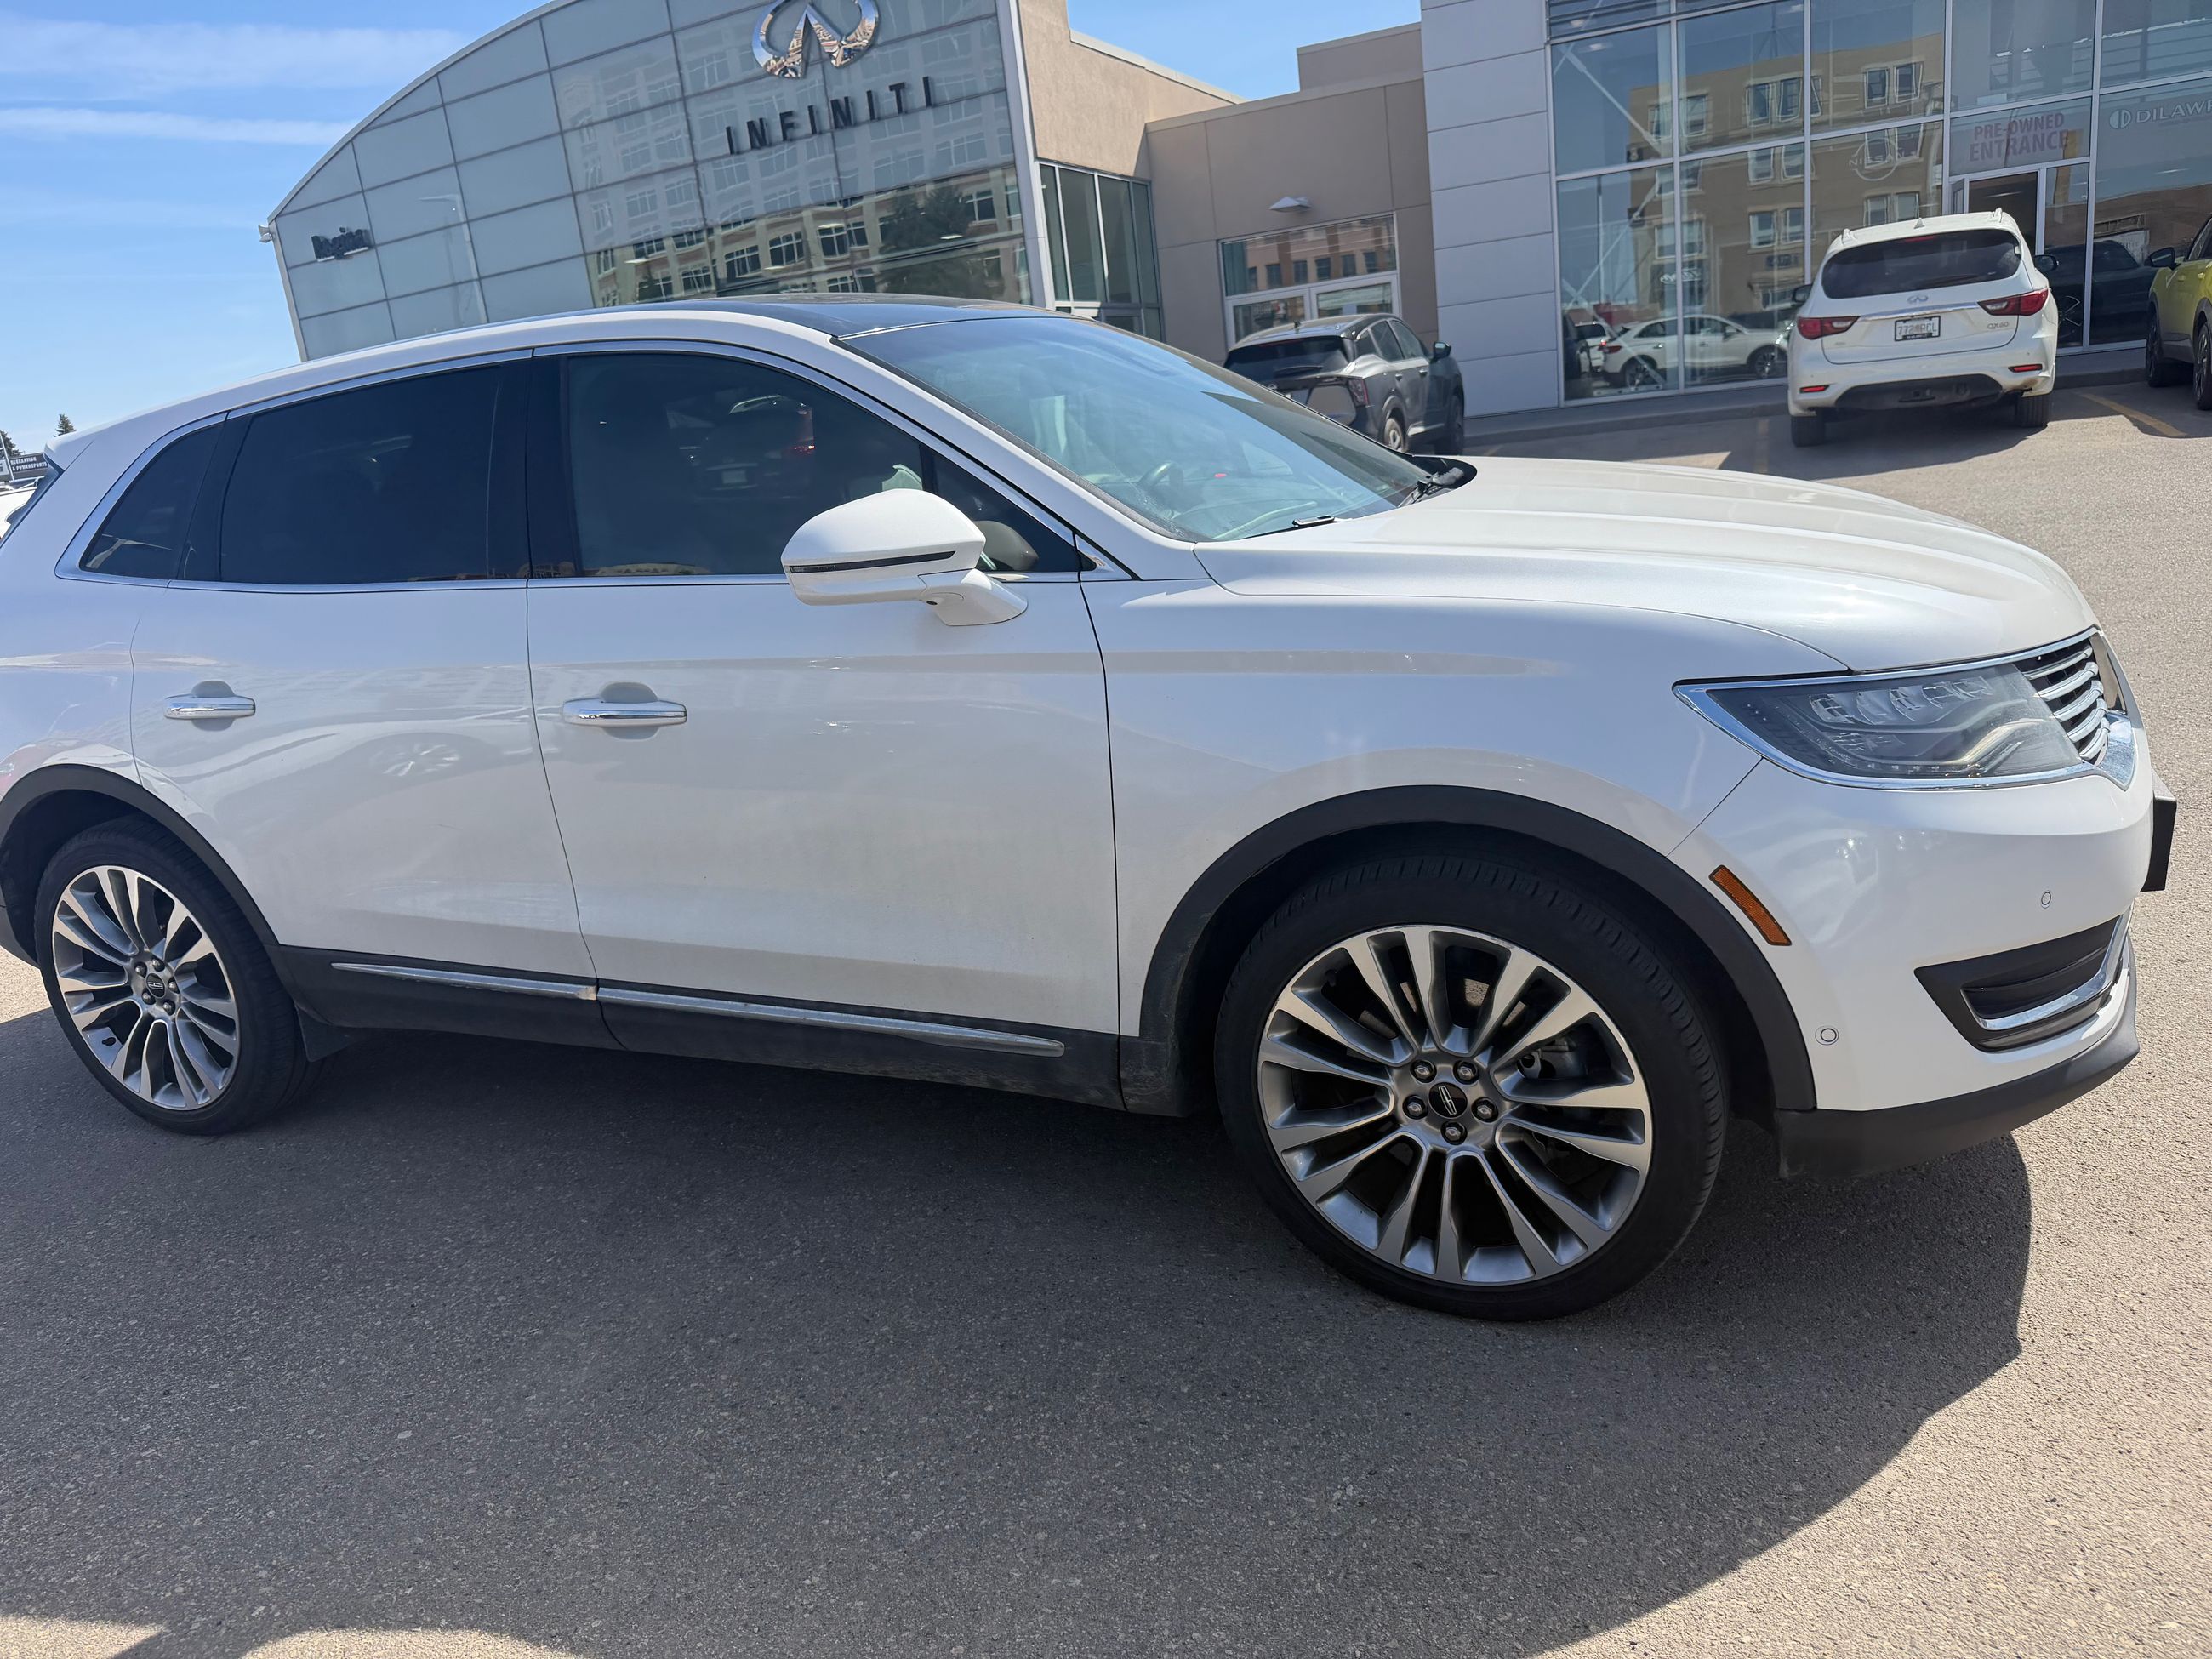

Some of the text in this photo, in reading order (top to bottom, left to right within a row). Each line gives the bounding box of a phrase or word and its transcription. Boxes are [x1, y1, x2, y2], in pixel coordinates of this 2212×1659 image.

[726, 76, 932, 155] INFINITI
[1974, 112, 2065, 140] PRE-OWNED
[1970, 130, 2068, 162] ENTRANCE
